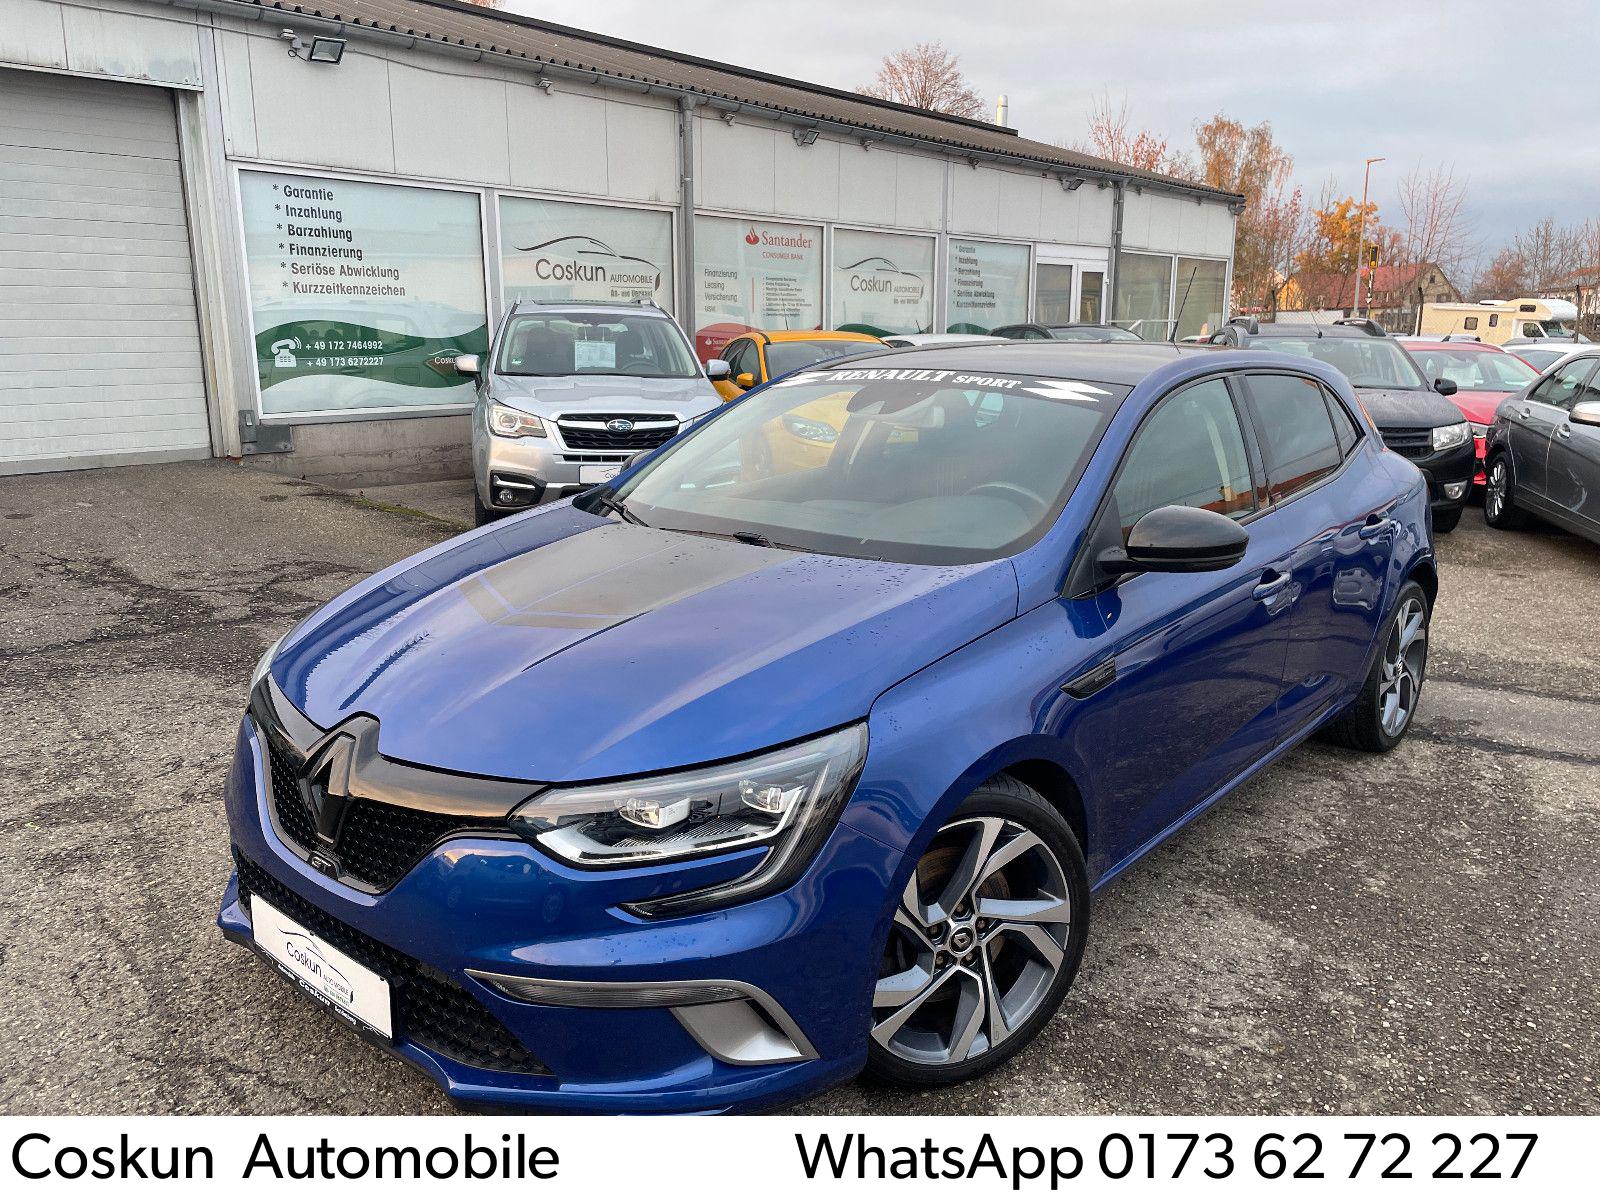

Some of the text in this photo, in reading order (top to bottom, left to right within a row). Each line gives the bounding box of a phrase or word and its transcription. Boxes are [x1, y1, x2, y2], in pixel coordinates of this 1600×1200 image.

[284, 185, 334, 201] Garantie
[286, 204, 342, 222] Inzahlung
[288, 224, 353, 242] Barzahlung
[762, 230, 812, 248] Santander
[290, 244, 363, 261] Finanzierung
[291, 262, 400, 280] Seriöse Abwicklung
[536, 258, 652, 284] Coskun AUTOMOBILE
[704, 268, 737, 279] Finanzierung
[293, 282, 406, 296] Kurzzeitkennzeichen
[704, 280, 724, 291] Leasing
[851, 275, 892, 292] Coskun
[704, 292, 737, 302] Versicherung
[314, 341, 326, 350] 49
[328, 341, 344, 350] 172
[346, 340, 382, 350] 7464992
[316, 358, 326, 366] 49
[330, 358, 345, 366] 173
[348, 357, 383, 366] 6272227
[828, 370, 1022, 389] RENAULT SPORT
[286, 942, 322, 977] Coskun
[299, 980, 331, 1006] Coskun
